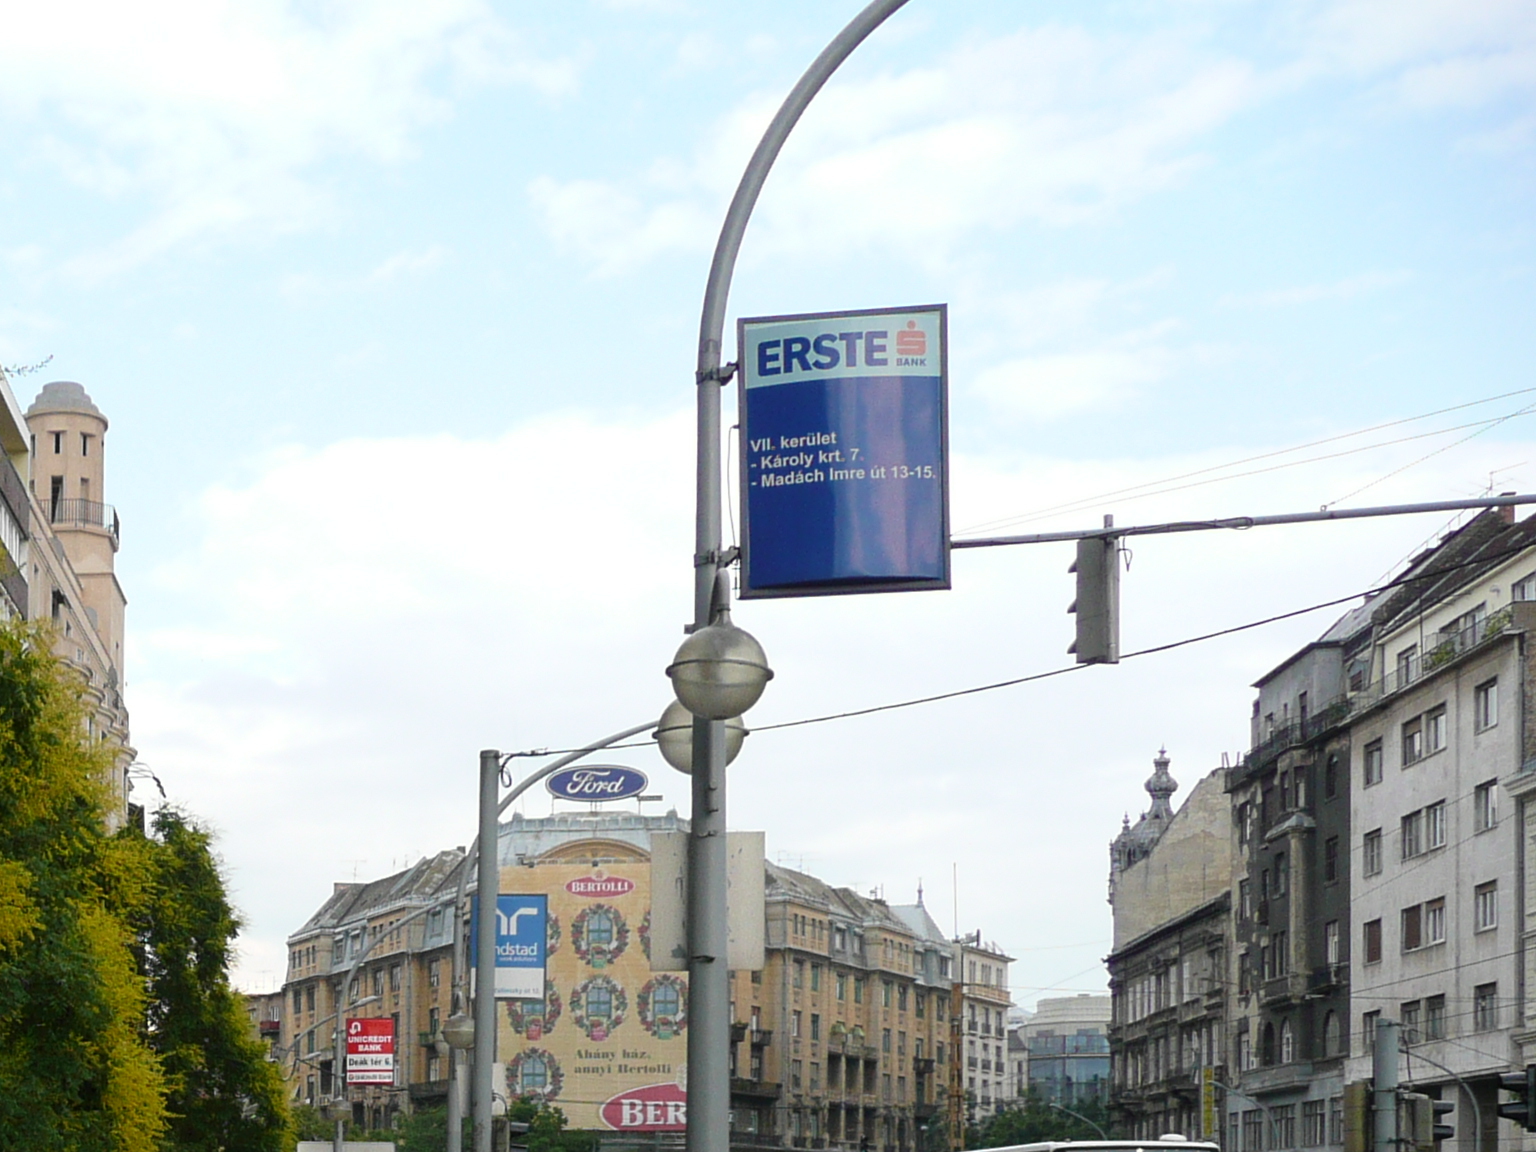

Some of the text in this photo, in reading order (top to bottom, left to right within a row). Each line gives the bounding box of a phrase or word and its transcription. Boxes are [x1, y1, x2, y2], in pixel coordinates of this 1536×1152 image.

[757, 330, 888, 377] ERSTE
[896, 357, 927, 367] BANK
[750, 432, 837, 452] VII. kerület
[761, 452, 814, 470] Károly
[818, 450, 846, 464] krt.
[850, 448, 864, 462] 7.
[761, 470, 824, 488] Madách
[829, 466, 865, 482] Imre
[871, 466, 886, 480] út
[891, 465, 936, 480] 13-15.
[566, 770, 625, 794] Ford
[572, 881, 628, 892] BERTOLLI
[495, 942, 538, 956] ndstad
[348, 1035, 392, 1044] UNICREDIT
[358, 1044, 382, 1052] BANK
[574, 1048, 616, 1062] Ahány
[348, 1058, 368, 1066] Deák
[370, 1058, 382, 1066] tér
[574, 1064, 672, 1076] annyi Bertolli
[620, 1098, 686, 1126] BER
